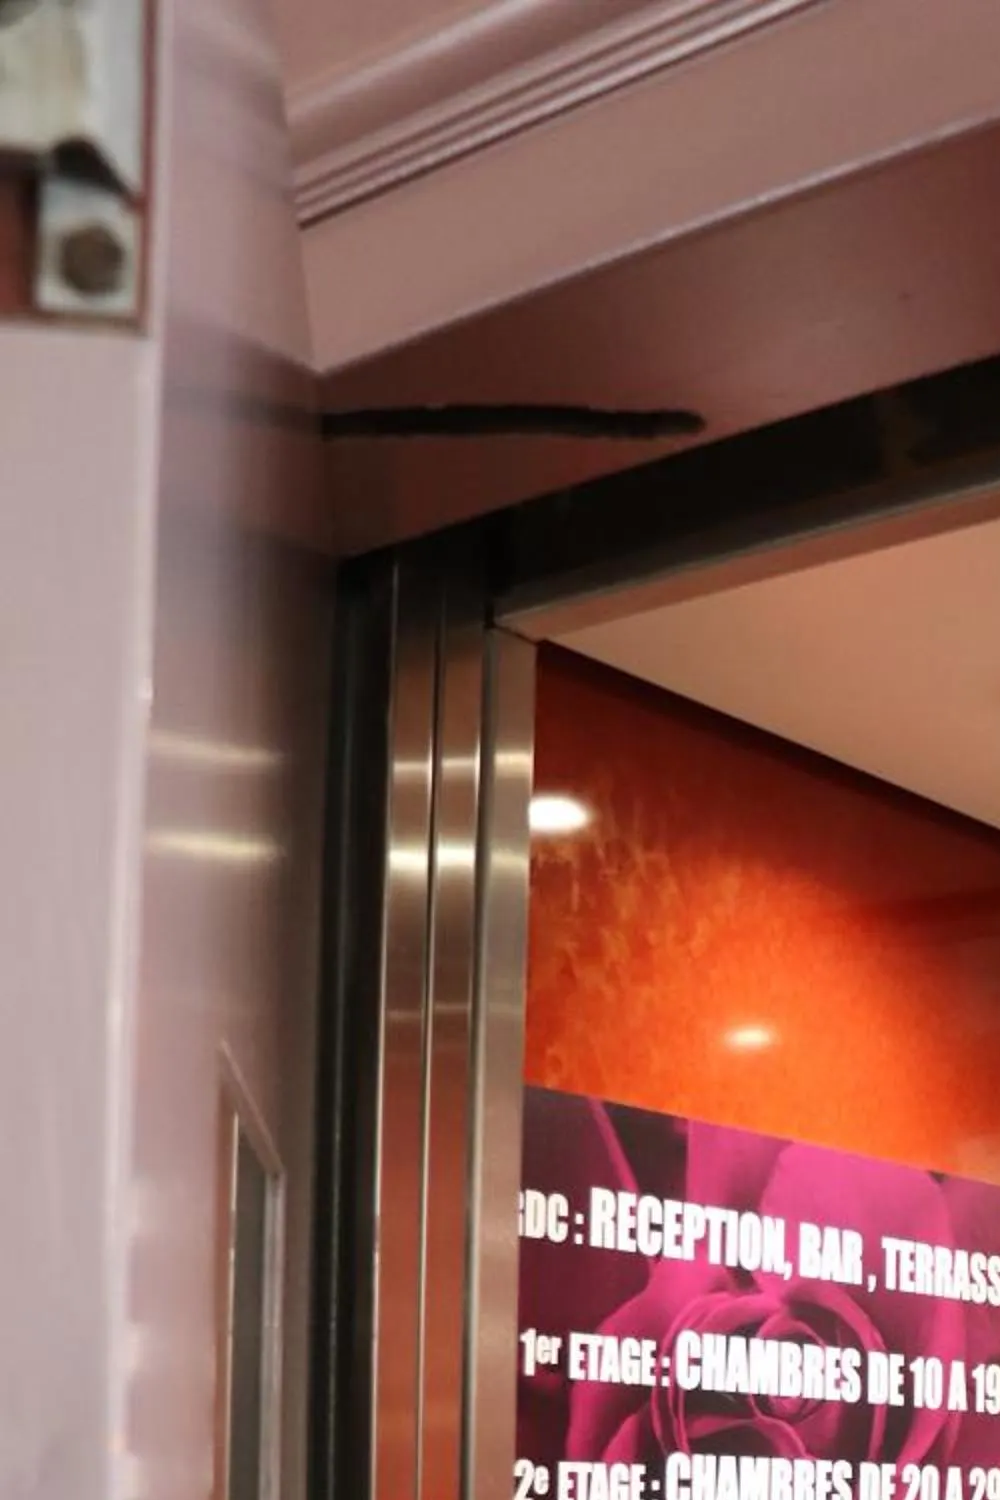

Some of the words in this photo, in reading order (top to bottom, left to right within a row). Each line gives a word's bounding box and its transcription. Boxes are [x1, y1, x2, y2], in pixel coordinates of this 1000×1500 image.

[517, 1189, 569, 1243] DC
[589, 1187, 793, 1281] RECEPTION,
[798, 1222, 863, 1285] BAR
[675, 1329, 862, 1403] CHAMBRES
[867, 1354, 905, 1407] DE
[909, 1357, 941, 1410] 10
[947, 1361, 968, 1411] A
